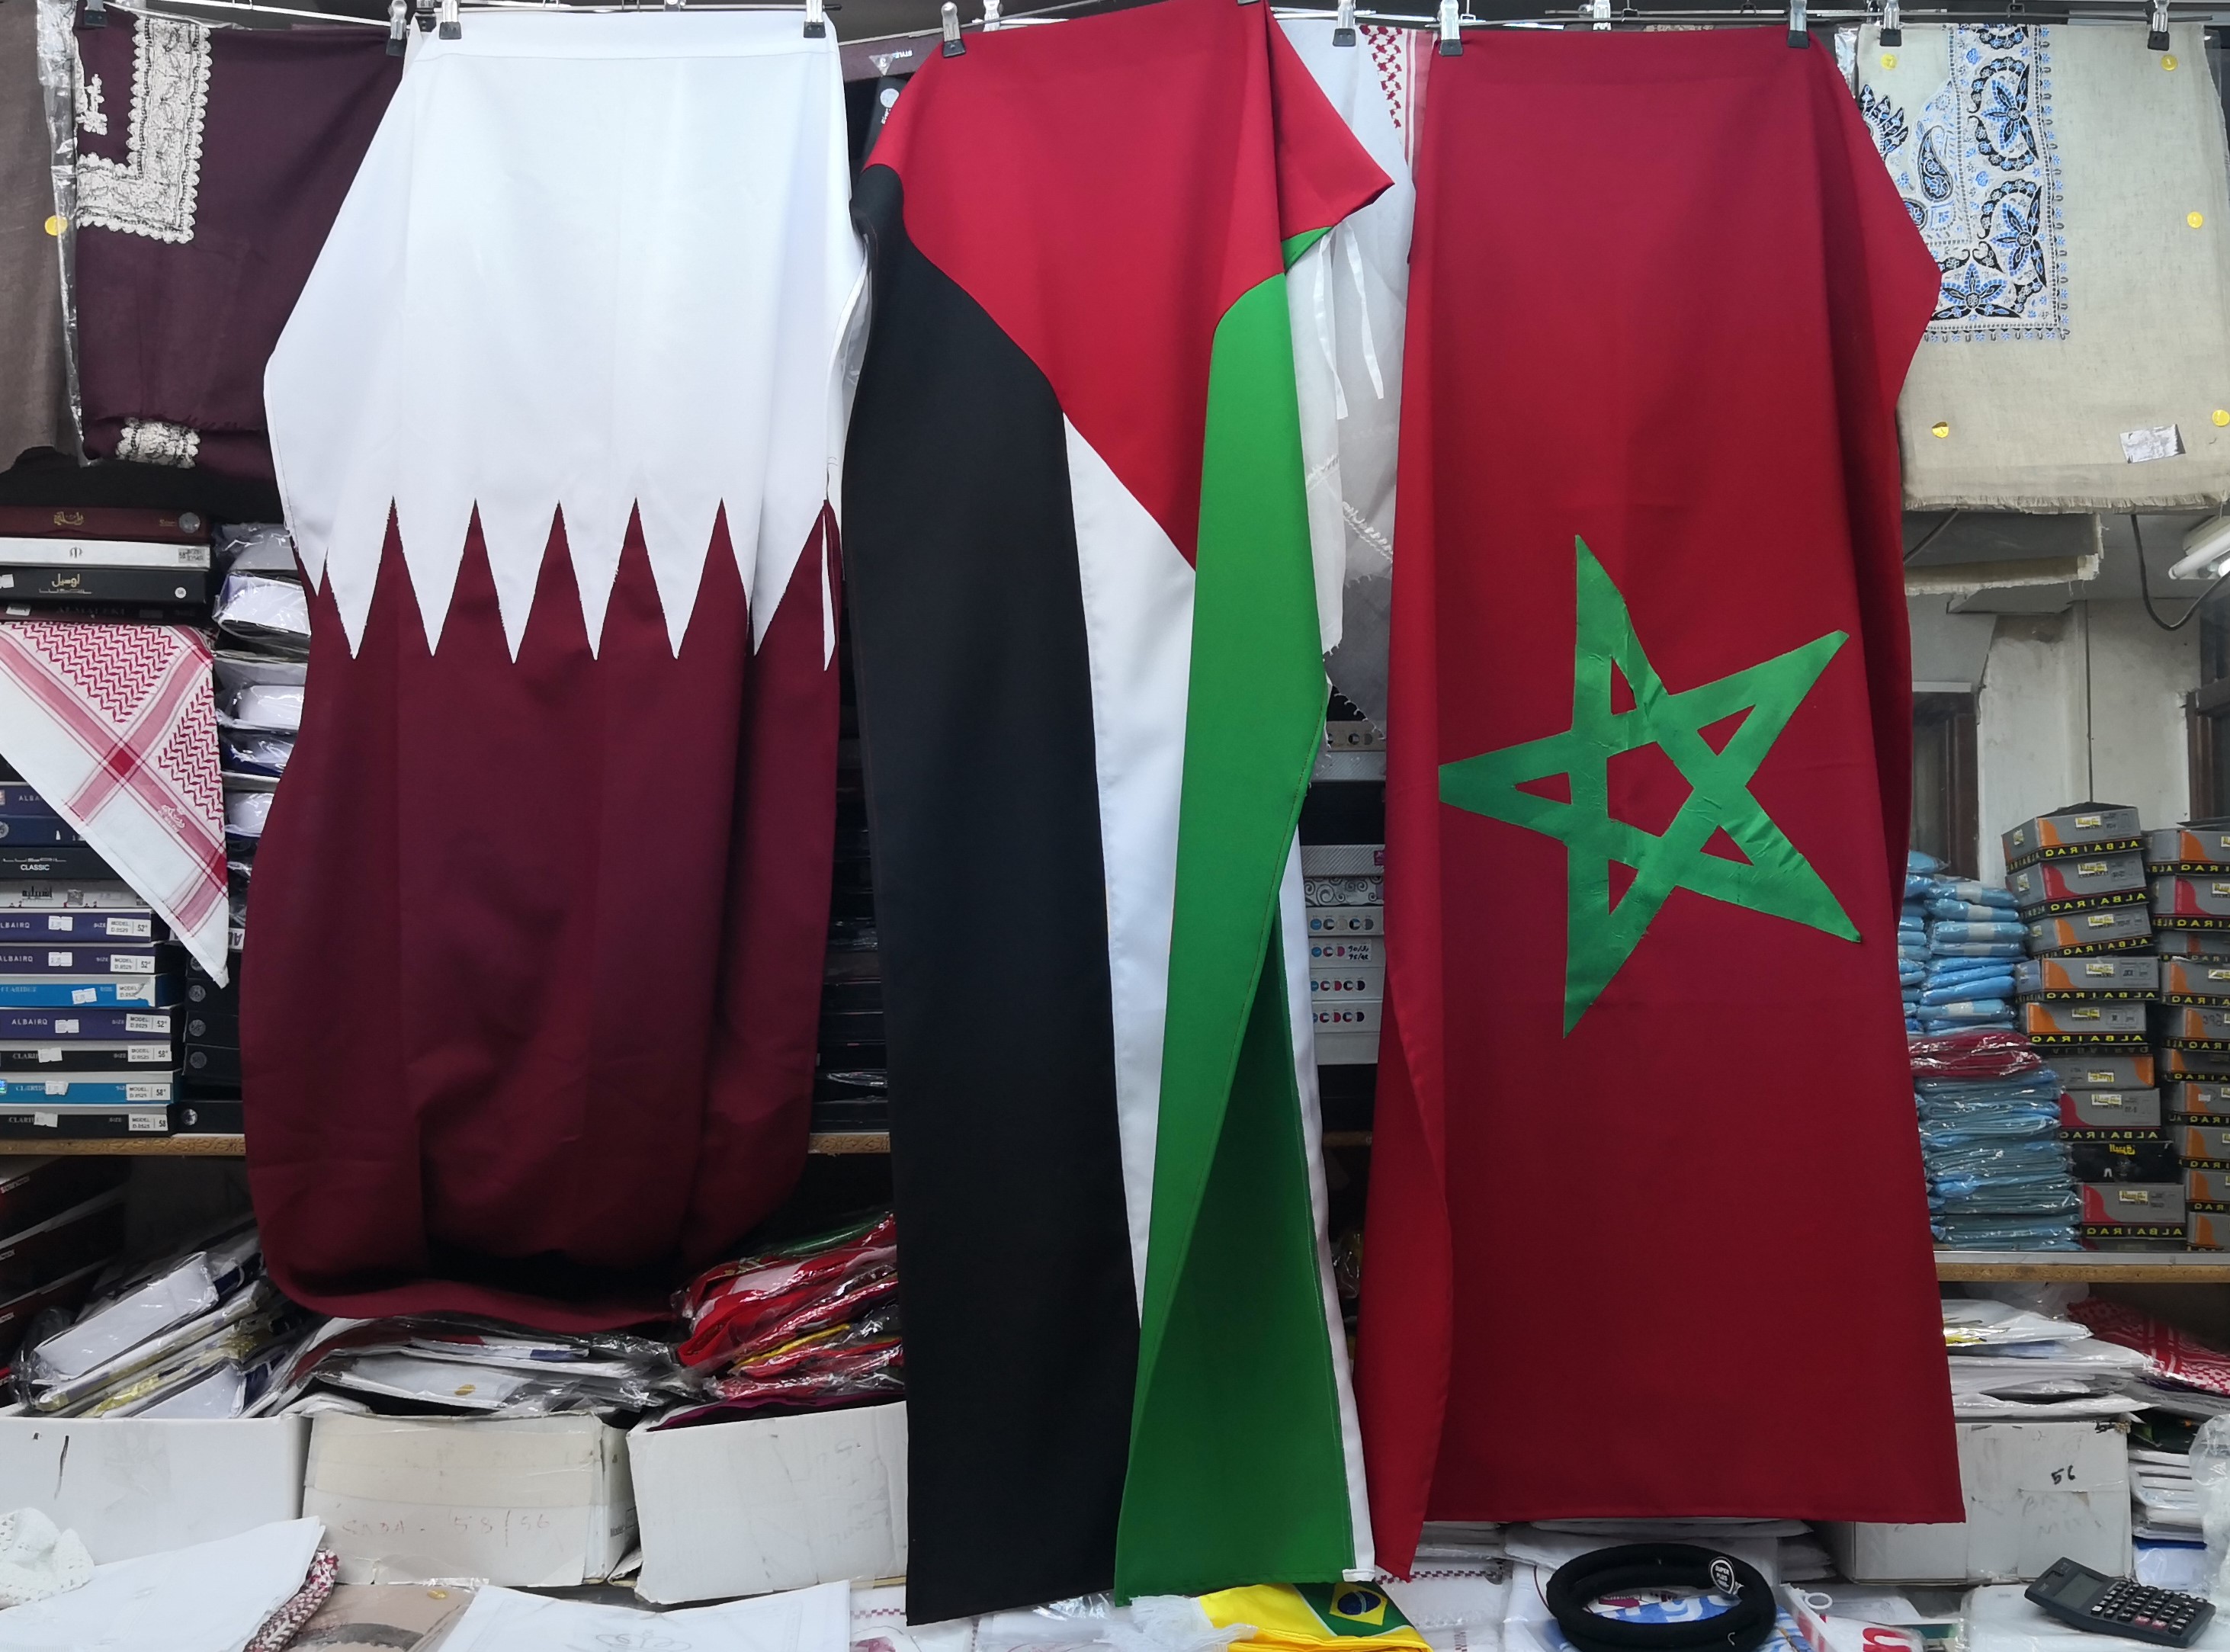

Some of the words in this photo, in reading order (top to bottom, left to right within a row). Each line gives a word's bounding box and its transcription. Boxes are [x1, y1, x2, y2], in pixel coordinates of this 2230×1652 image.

[2051, 1464, 2076, 1485] 56
[1715, 1565, 1730, 1576] SUPER
[1716, 1572, 1728, 1582] PLUS
